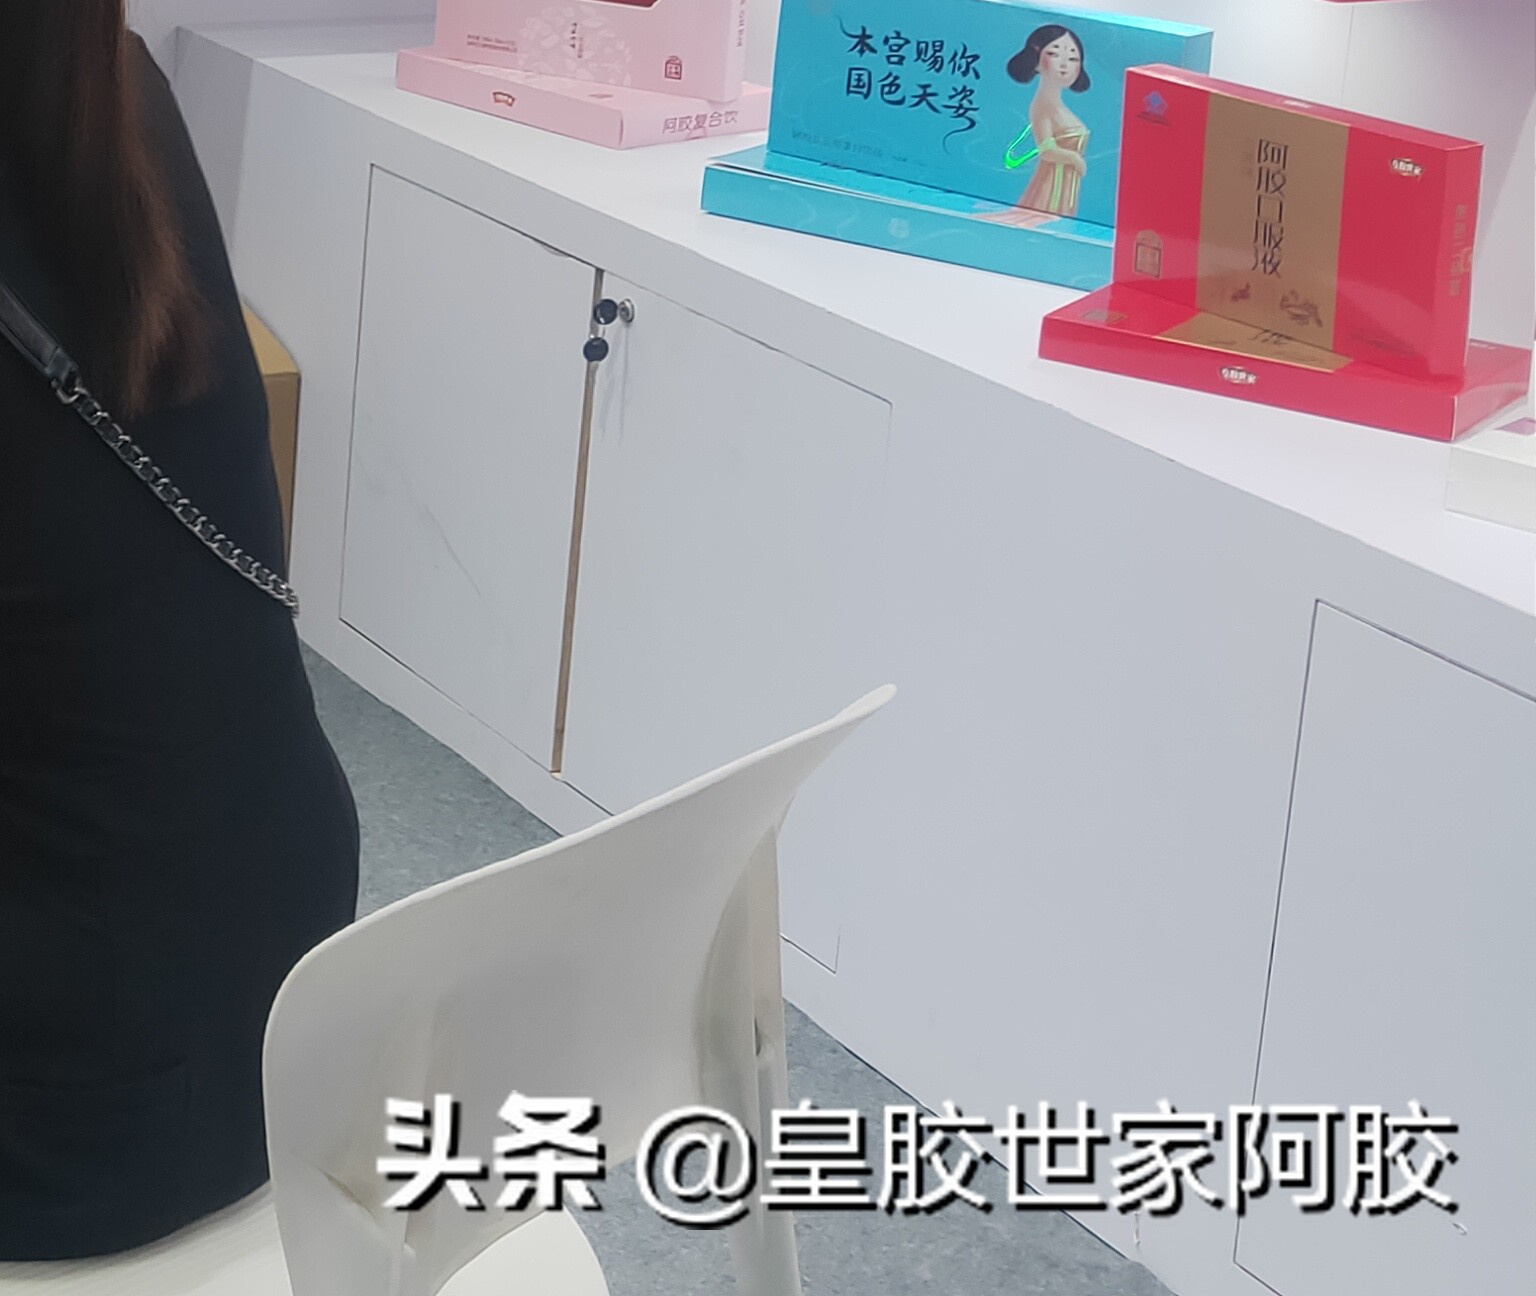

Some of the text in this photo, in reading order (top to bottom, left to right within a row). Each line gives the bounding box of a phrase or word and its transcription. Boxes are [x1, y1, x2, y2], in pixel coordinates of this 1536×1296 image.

[841, 20, 981, 81] 本宫赐你
[662, 110, 738, 135] 阿胶复合饮
[846, 66, 981, 151] 国色天姿
[1252, 138, 1289, 279] 阿胶口服液
